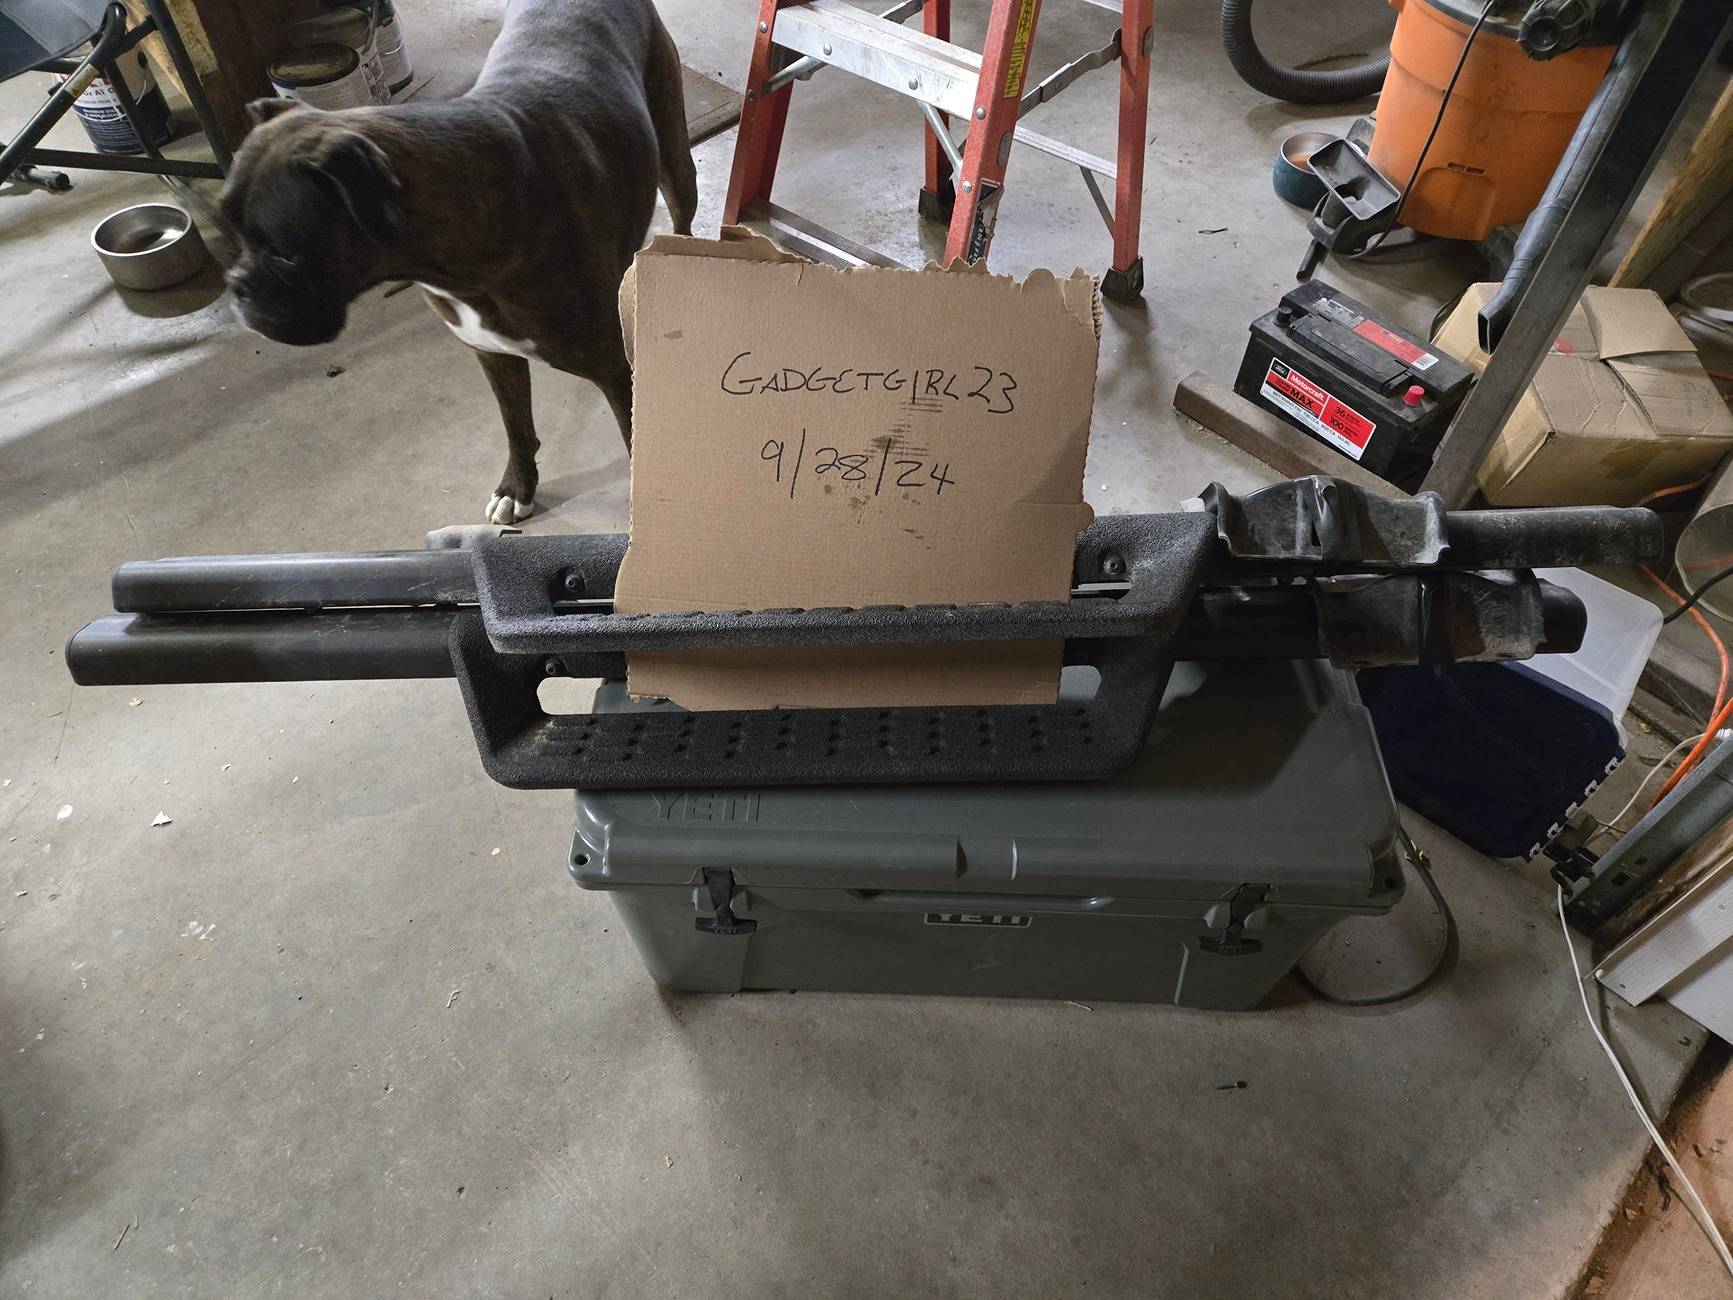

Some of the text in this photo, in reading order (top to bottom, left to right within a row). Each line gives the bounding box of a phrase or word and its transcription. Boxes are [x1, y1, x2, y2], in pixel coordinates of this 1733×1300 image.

[1290, 374, 1325, 401] Motorcraft
[1290, 388, 1314, 408] MAX
[1330, 417, 1344, 430] 100
[761, 428, 955, 499] 9/28/24
[650, 788, 760, 822] YETI
